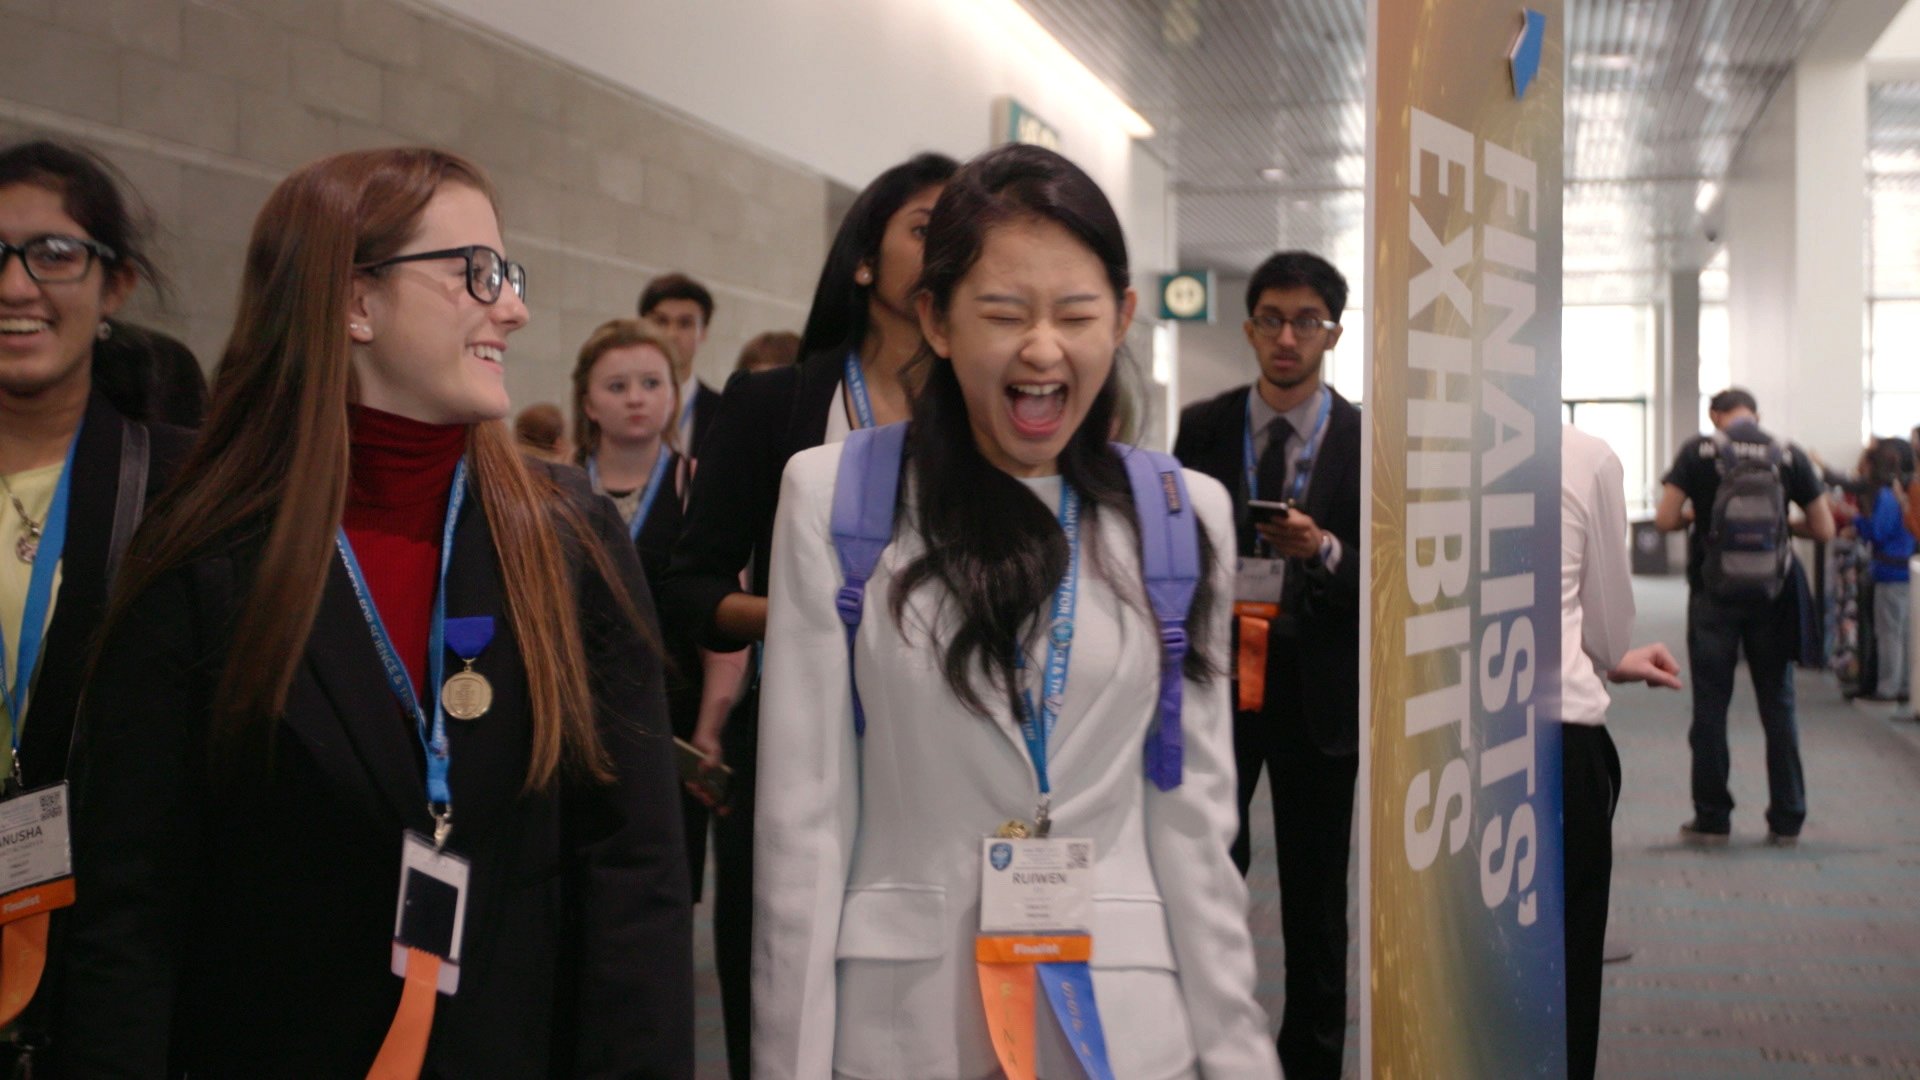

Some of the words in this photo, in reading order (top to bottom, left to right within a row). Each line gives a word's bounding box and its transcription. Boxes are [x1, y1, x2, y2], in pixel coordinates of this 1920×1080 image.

[1404, 106, 1474, 871] EXHIBITS
[1480, 140, 1537, 927] FINALISTS'
[1057, 591, 1073, 614] FOR
[370, 624, 398, 674] SCIENCE
[0, 825, 42, 846] NUSHA
[1012, 873, 1066, 884] RUIWEN
